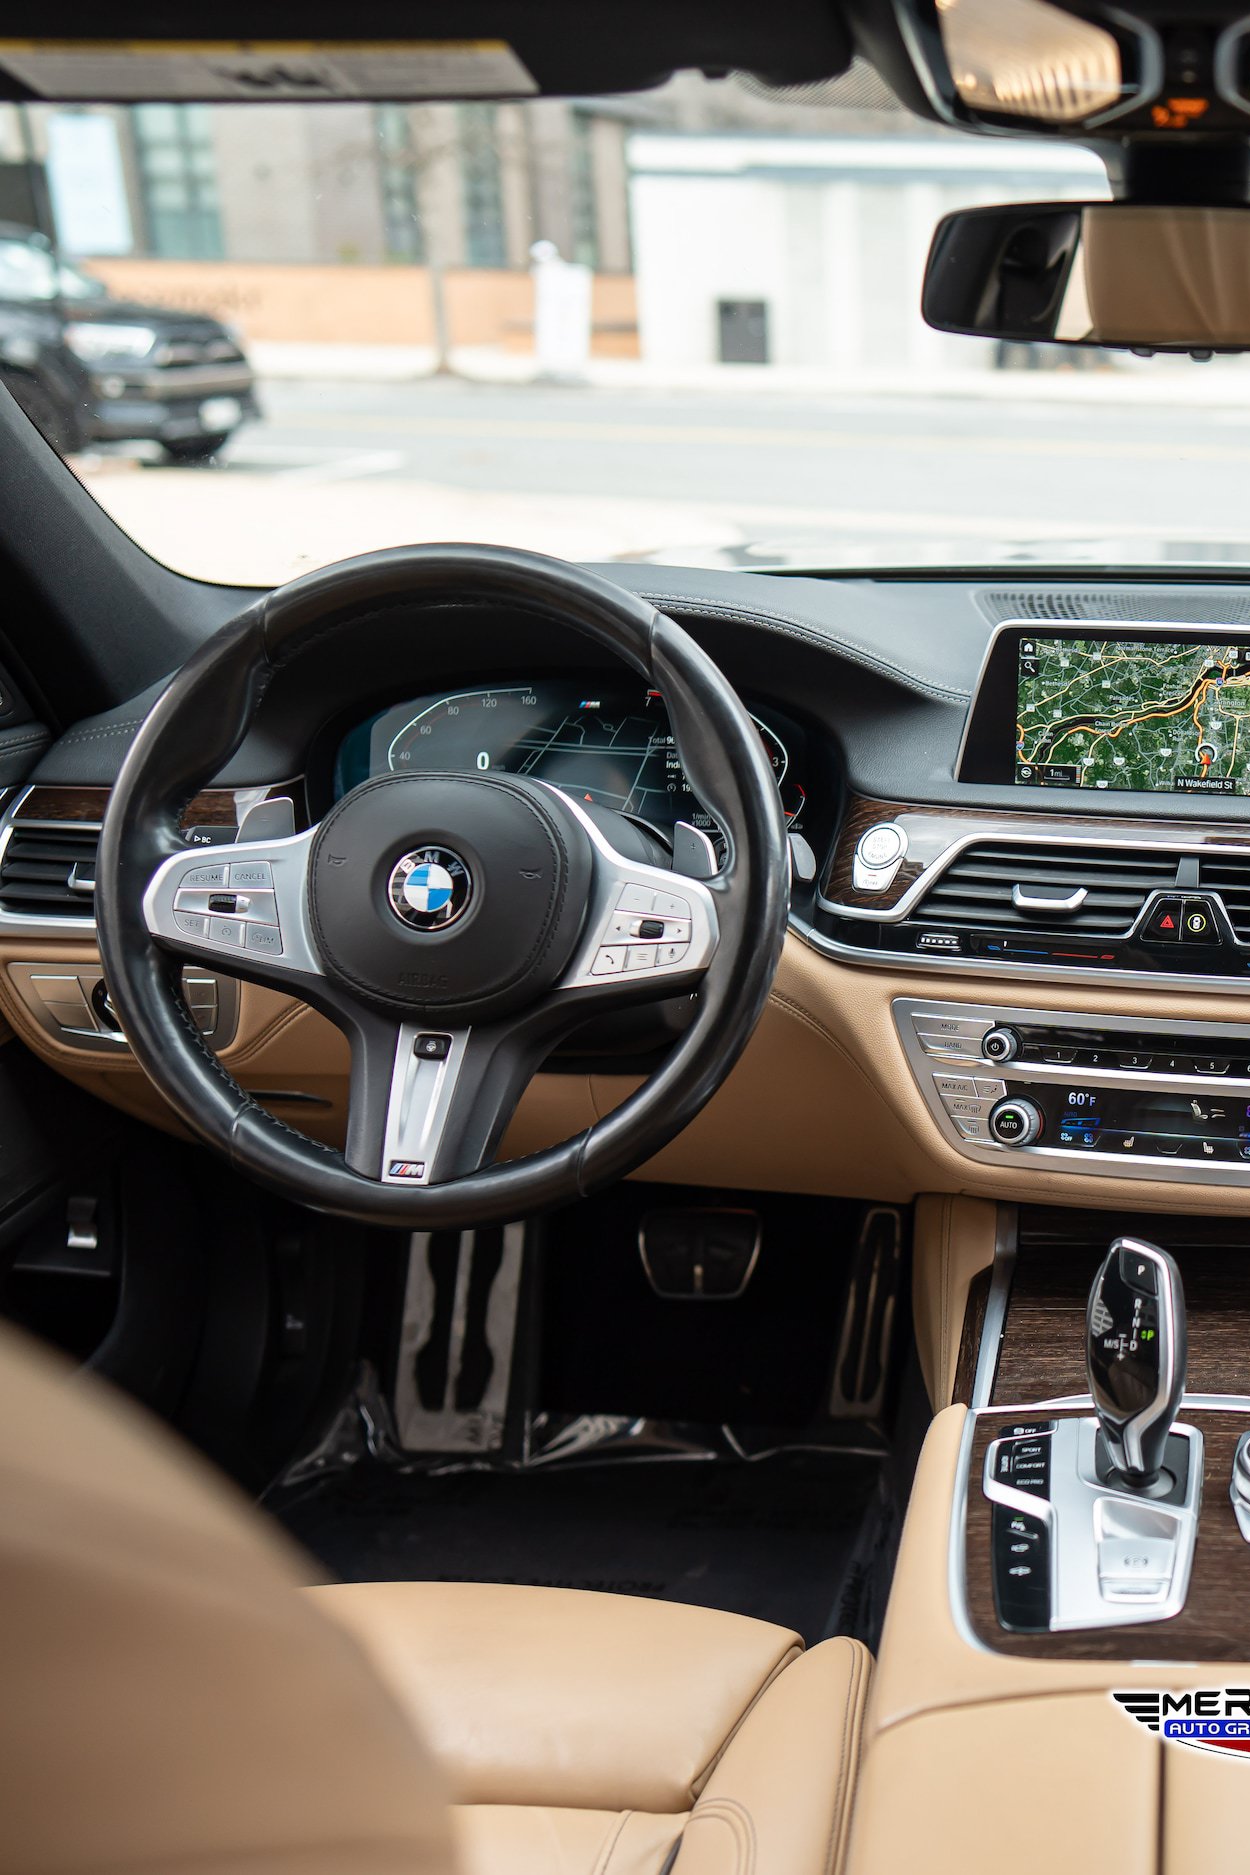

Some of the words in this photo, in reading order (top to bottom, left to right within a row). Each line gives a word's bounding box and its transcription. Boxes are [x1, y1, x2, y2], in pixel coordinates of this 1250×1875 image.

[481, 698, 497, 708] 120
[521, 695, 537, 705] 160
[644, 696, 652, 707] 7
[447, 706, 460, 716] 80
[420, 725, 432, 735] 60
[399, 751, 411, 761] 40
[476, 751, 490, 771] 0
[772, 757, 779, 767] 3
[1177, 779, 1184, 787] N
[1185, 779, 1223, 789] Wakefield
[201, 836, 212, 844] BC
[400, 850, 465, 878] BMW
[189, 873, 224, 883] RESUME
[234, 872, 267, 881] CANCEL
[184, 919, 201, 927] SET
[1092, 1054, 1099, 1063] 2
[1132, 1056, 1138, 1065] 3
[1169, 1059, 1175, 1068] 4
[1209, 1062, 1215, 1070] 5
[1068, 1091, 1097, 1107] 60°F
[999, 1121, 1018, 1130] AUTO
[1138, 1264, 1146, 1276] P
[1134, 1298, 1142, 1309] R
[1132, 1317, 1141, 1329] N
[1103, 1338, 1119, 1350] M/S
[1129, 1339, 1138, 1352] D
[1015, 1461, 1045, 1469] COMFORT
